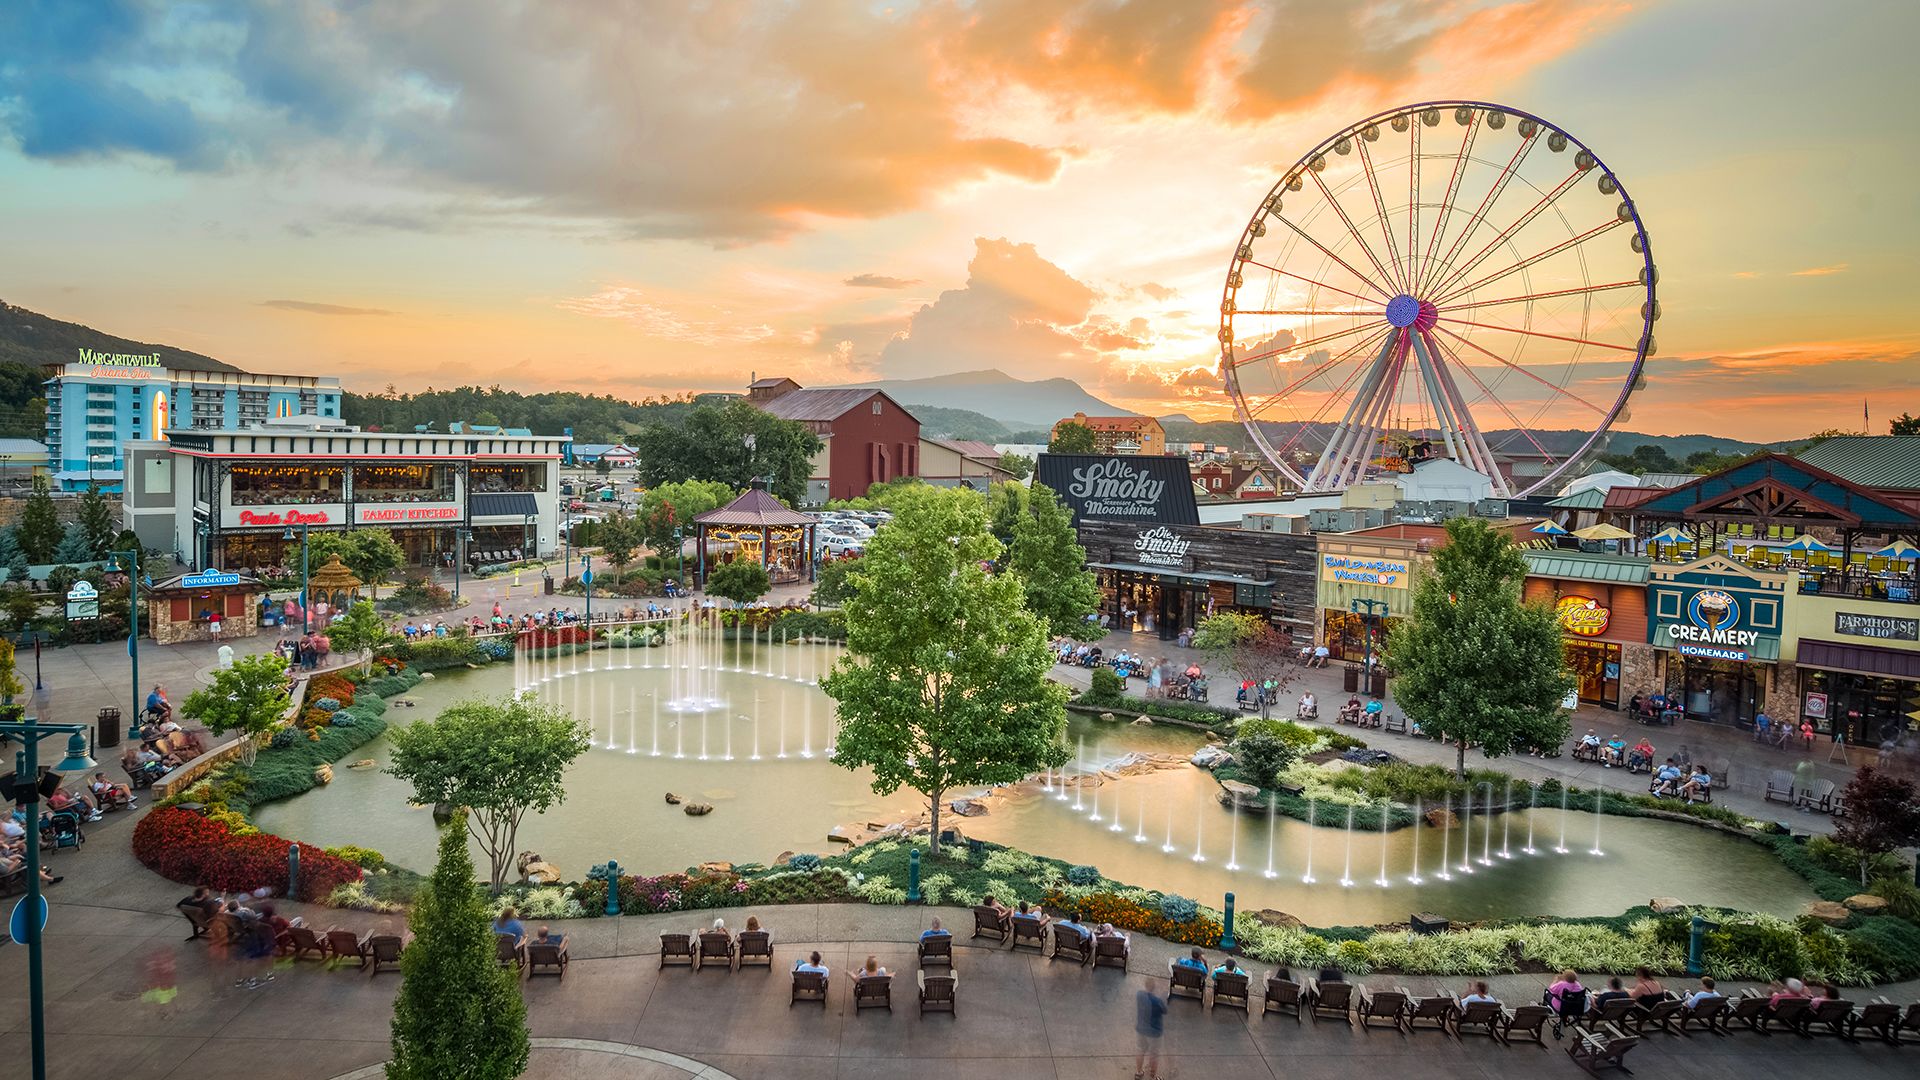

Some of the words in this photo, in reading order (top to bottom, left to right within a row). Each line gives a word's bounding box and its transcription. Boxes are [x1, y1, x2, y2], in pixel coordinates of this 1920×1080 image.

[79, 348, 161, 367] MARGARITAVILLE
[90, 365, 128, 379] Island
[1105, 458, 1138, 480] Ole
[1069, 463, 1165, 505] Smoky
[362, 509, 405, 521] FAMILY
[407, 507, 458, 520] KITCHEN
[1084, 500, 1157, 517] Moonshine
[239, 510, 282, 526] Paula
[1156, 526, 1174, 540] Ole
[1133, 529, 1191, 558] Smoky
[184, 576, 237, 585] INFORMATION
[1696, 590, 1733, 605] ISLAND
[1838, 615, 1916, 636] FARMHOUSE
[1863, 627, 1889, 638] 9110
[1668, 623, 1759, 646] CREAMERY
[1682, 646, 1744, 660] HOMEMADE
